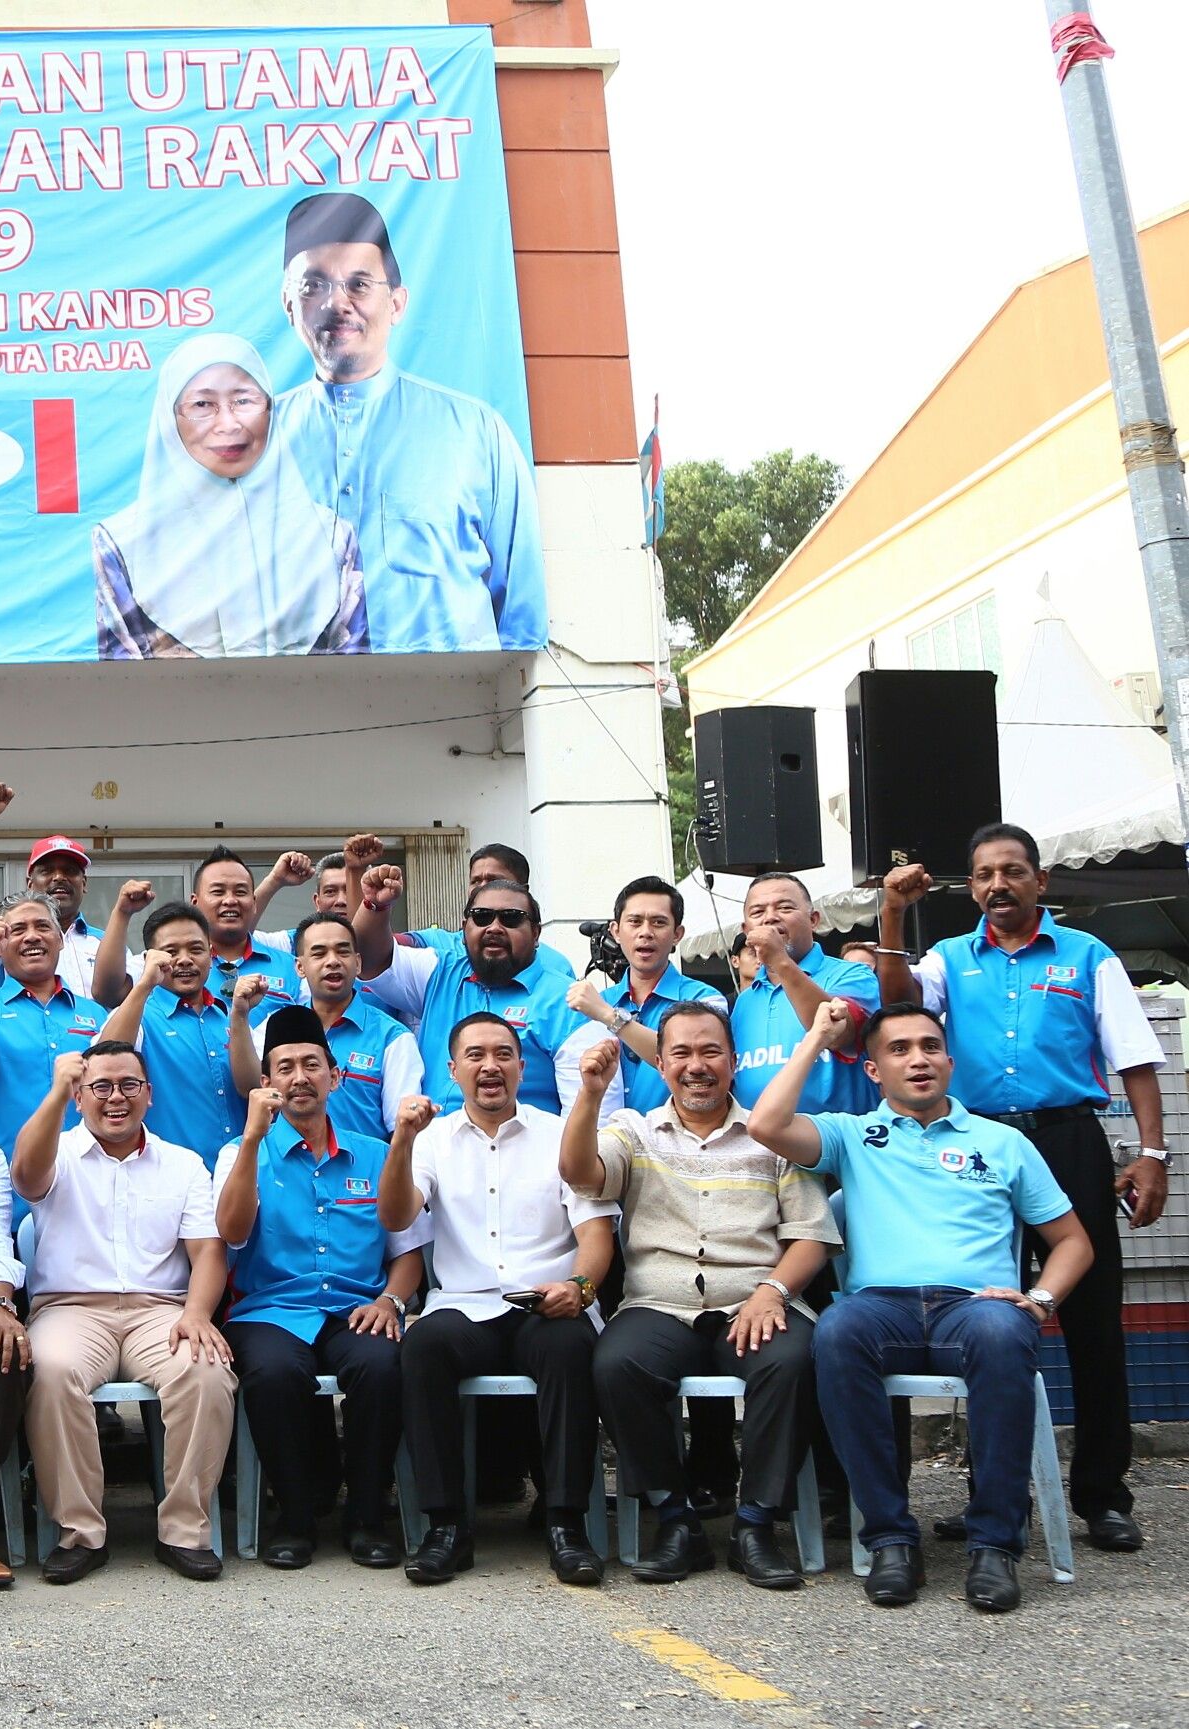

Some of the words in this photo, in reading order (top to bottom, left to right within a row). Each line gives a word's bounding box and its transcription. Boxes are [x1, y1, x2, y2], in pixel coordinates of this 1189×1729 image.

[125, 46, 436, 111] UTAMA
[145, 117, 472, 190] RAKYAT
[19, 288, 214, 332] KANDIS
[52, 340, 151, 371] RAJA
[91, 781, 118, 800] 49
[863, 1124, 889, 1148] 2
